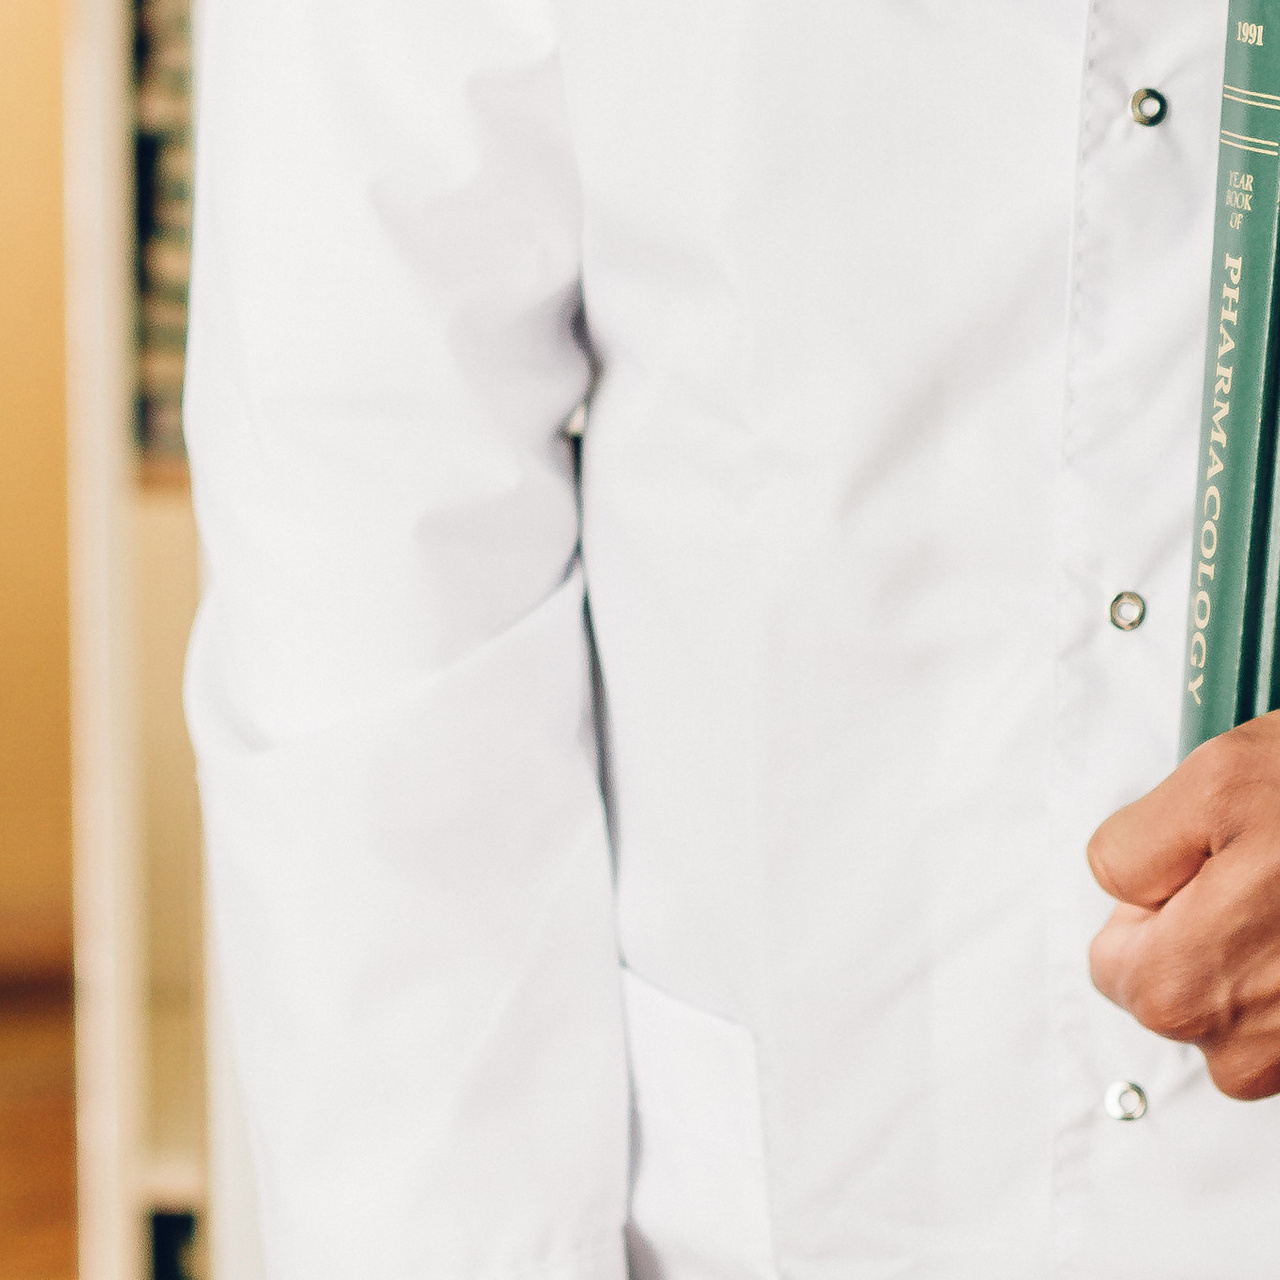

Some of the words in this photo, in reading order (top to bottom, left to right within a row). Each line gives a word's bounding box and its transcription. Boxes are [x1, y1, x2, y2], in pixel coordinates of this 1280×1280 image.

[1236, 21, 1264, 47] 1991
[1228, 169, 1255, 192] YEAR
[1225, 191, 1253, 212] BOOK
[1229, 212, 1244, 231] OF
[1187, 252, 1243, 705] PHARMACOLOGY
